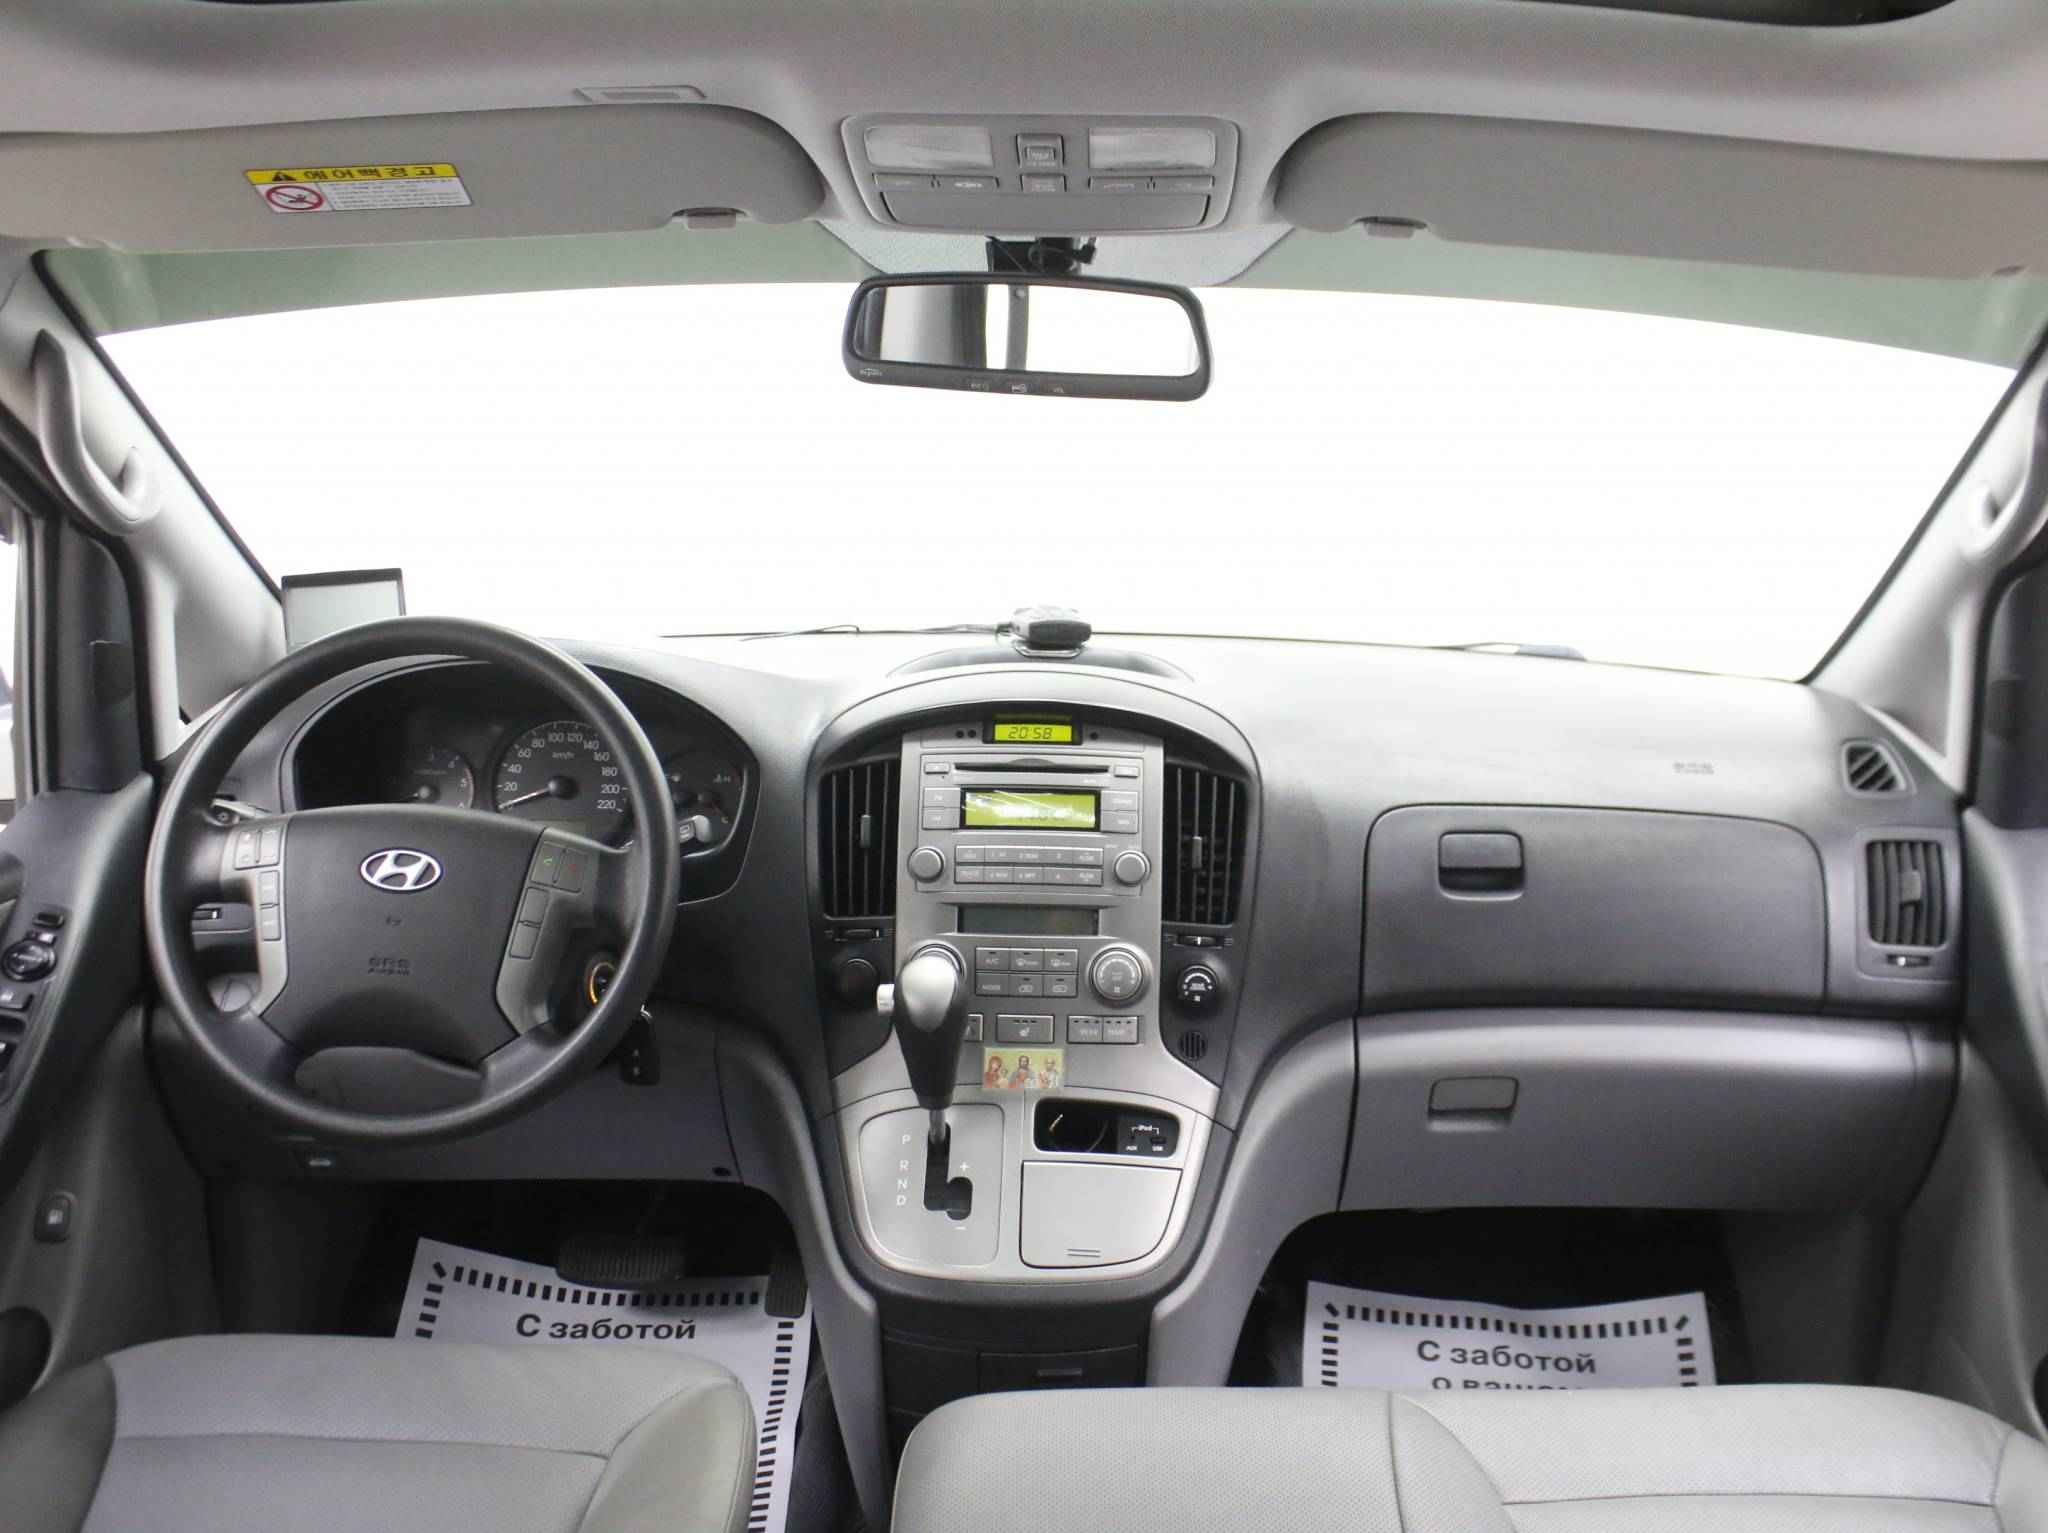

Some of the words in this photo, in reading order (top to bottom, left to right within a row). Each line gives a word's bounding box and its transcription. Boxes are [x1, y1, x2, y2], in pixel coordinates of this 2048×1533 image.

[548, 733, 564, 742] 100
[567, 733, 583, 742] 120
[531, 739, 545, 748] 80
[518, 748, 532, 758] 60
[593, 752, 610, 761] 160
[507, 764, 522, 774] 40
[503, 782, 518, 791] 20
[601, 784, 620, 794] 200
[597, 799, 616, 809] 220
[901, 1134, 911, 1145] P
[899, 1159, 910, 1170] R
[897, 1179, 908, 1190] N
[896, 1194, 907, 1206] D
[516, 1313, 541, 1337] С
[550, 1318, 696, 1340] заботой
[1417, 1340, 1440, 1361] С
[1450, 1345, 1597, 1374] заботой
